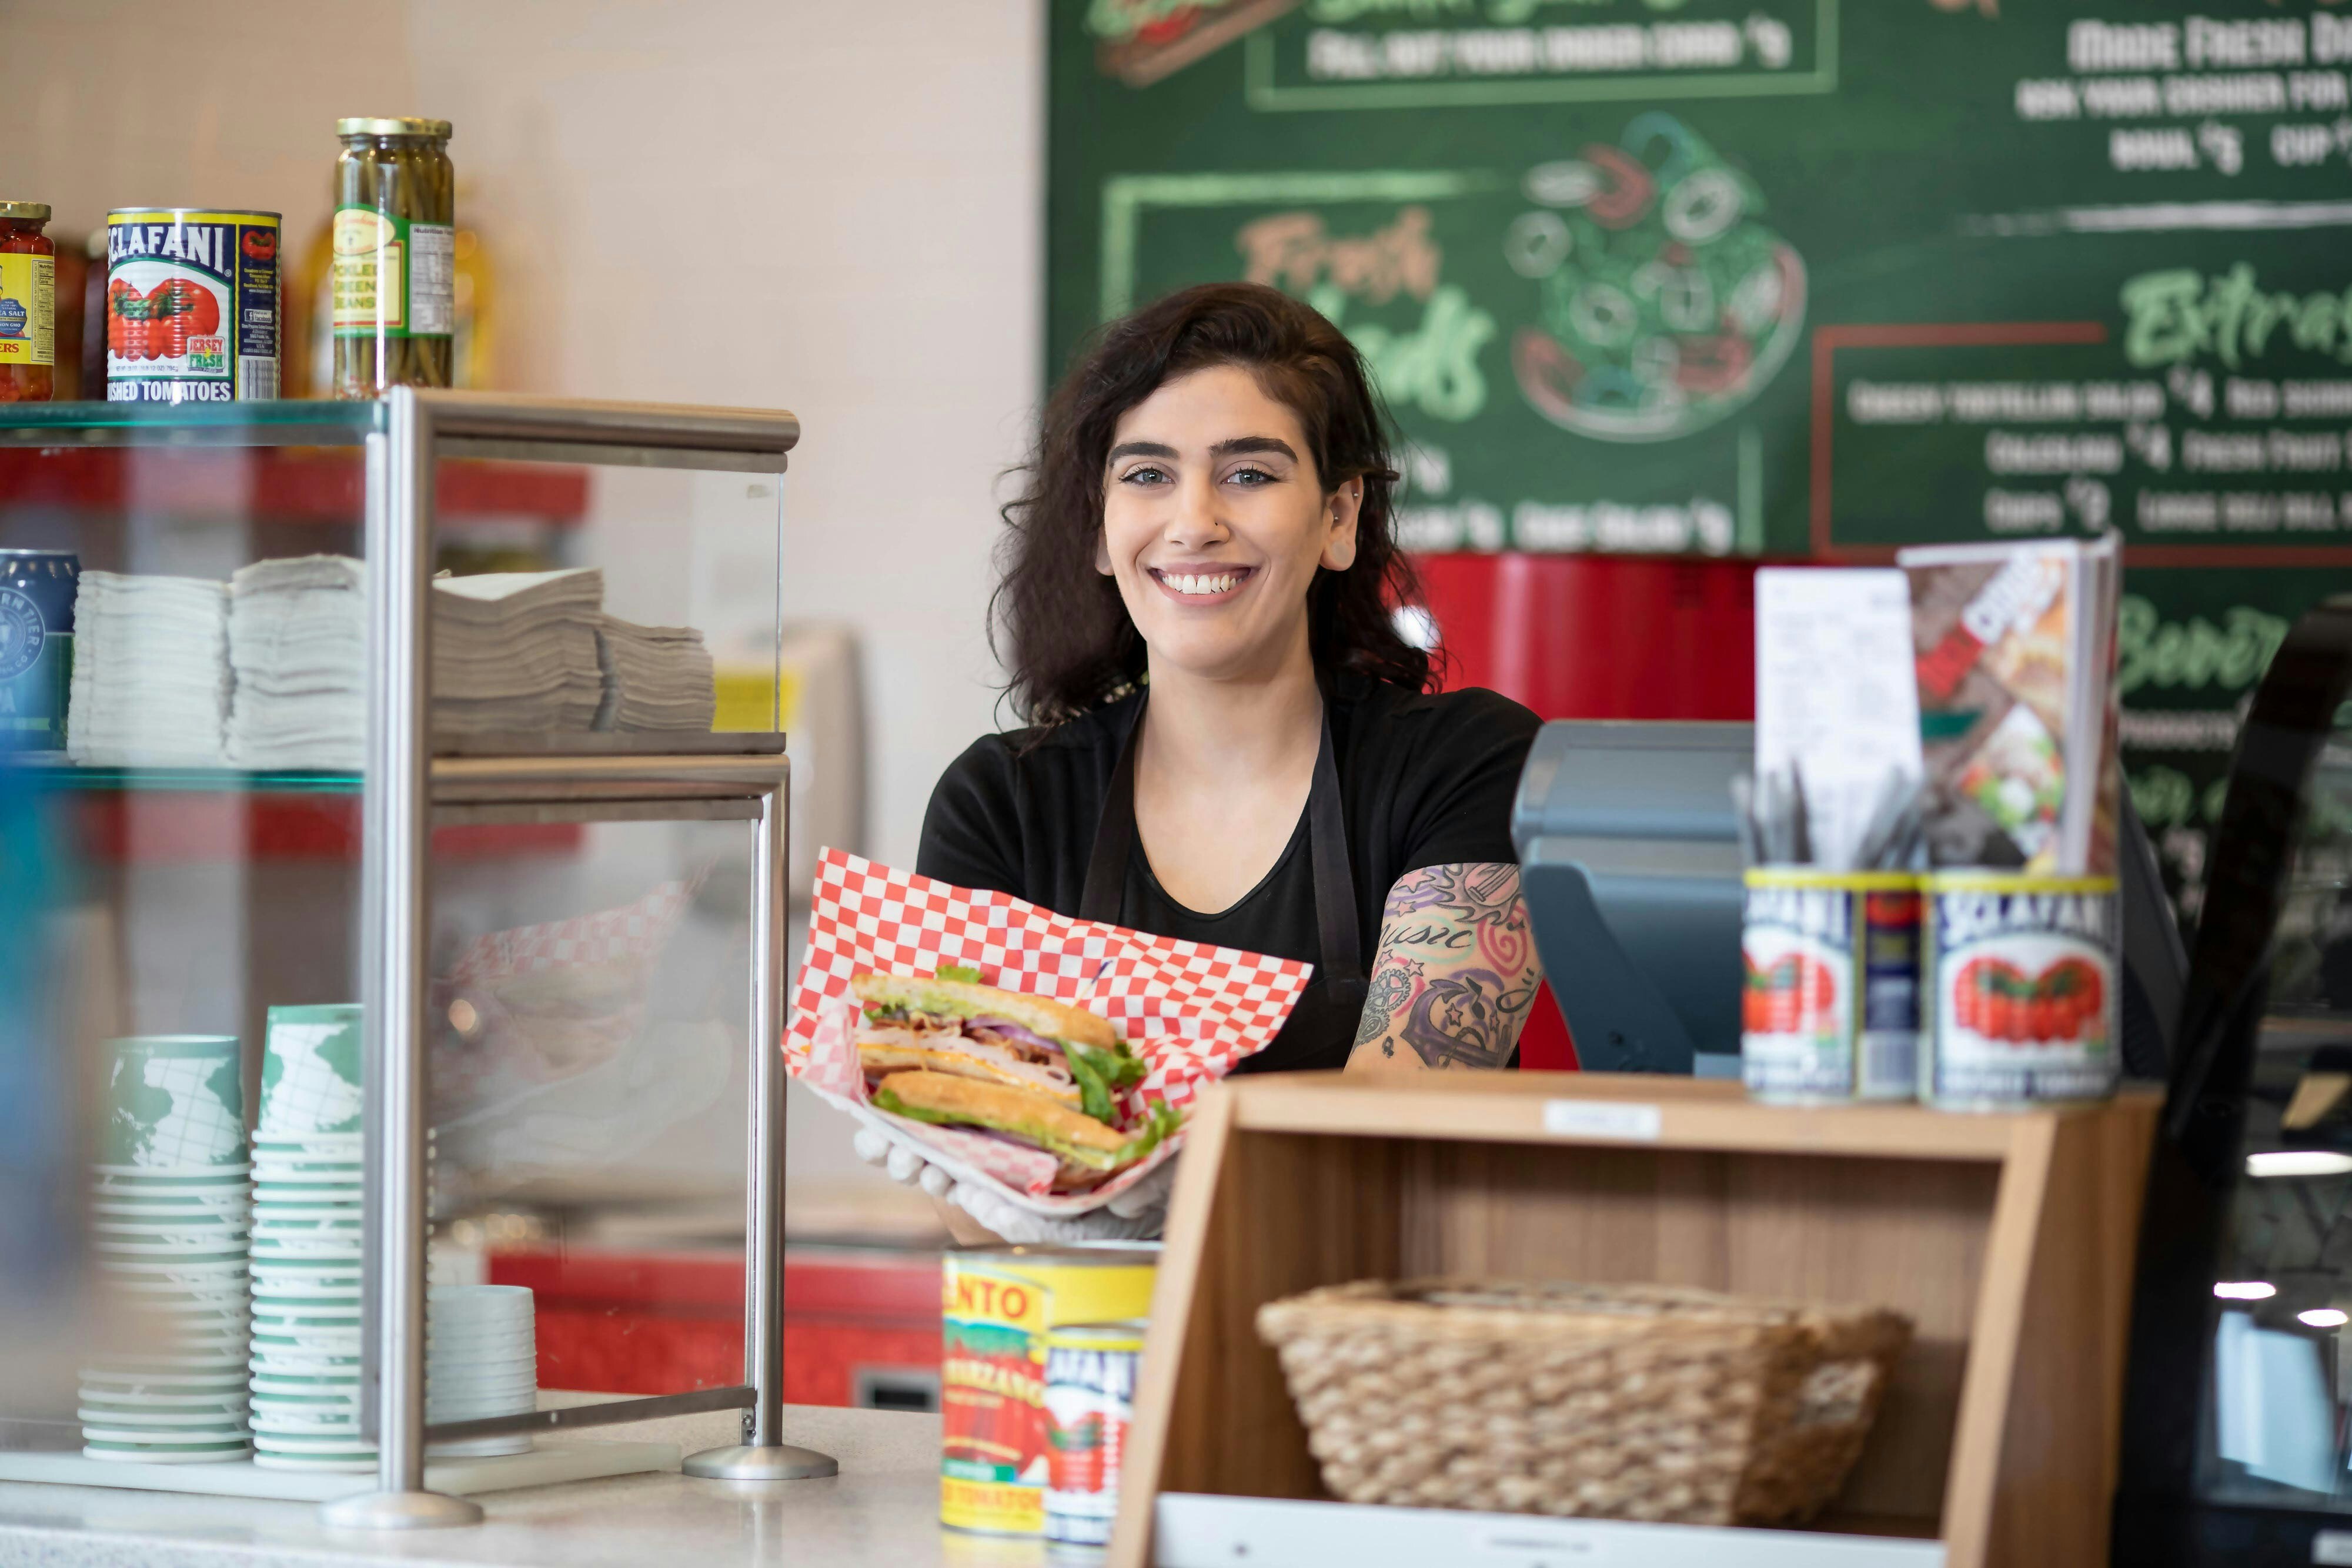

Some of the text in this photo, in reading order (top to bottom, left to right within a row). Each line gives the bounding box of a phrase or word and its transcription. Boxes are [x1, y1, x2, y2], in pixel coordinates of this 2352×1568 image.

[108, 226, 223, 274] CLAFANI
[189, 339, 223, 352] JERSEY
[189, 354, 223, 367] FRESH
[142, 382, 231, 401] TOMATOES
[944, 1277, 1028, 1319] NTO
